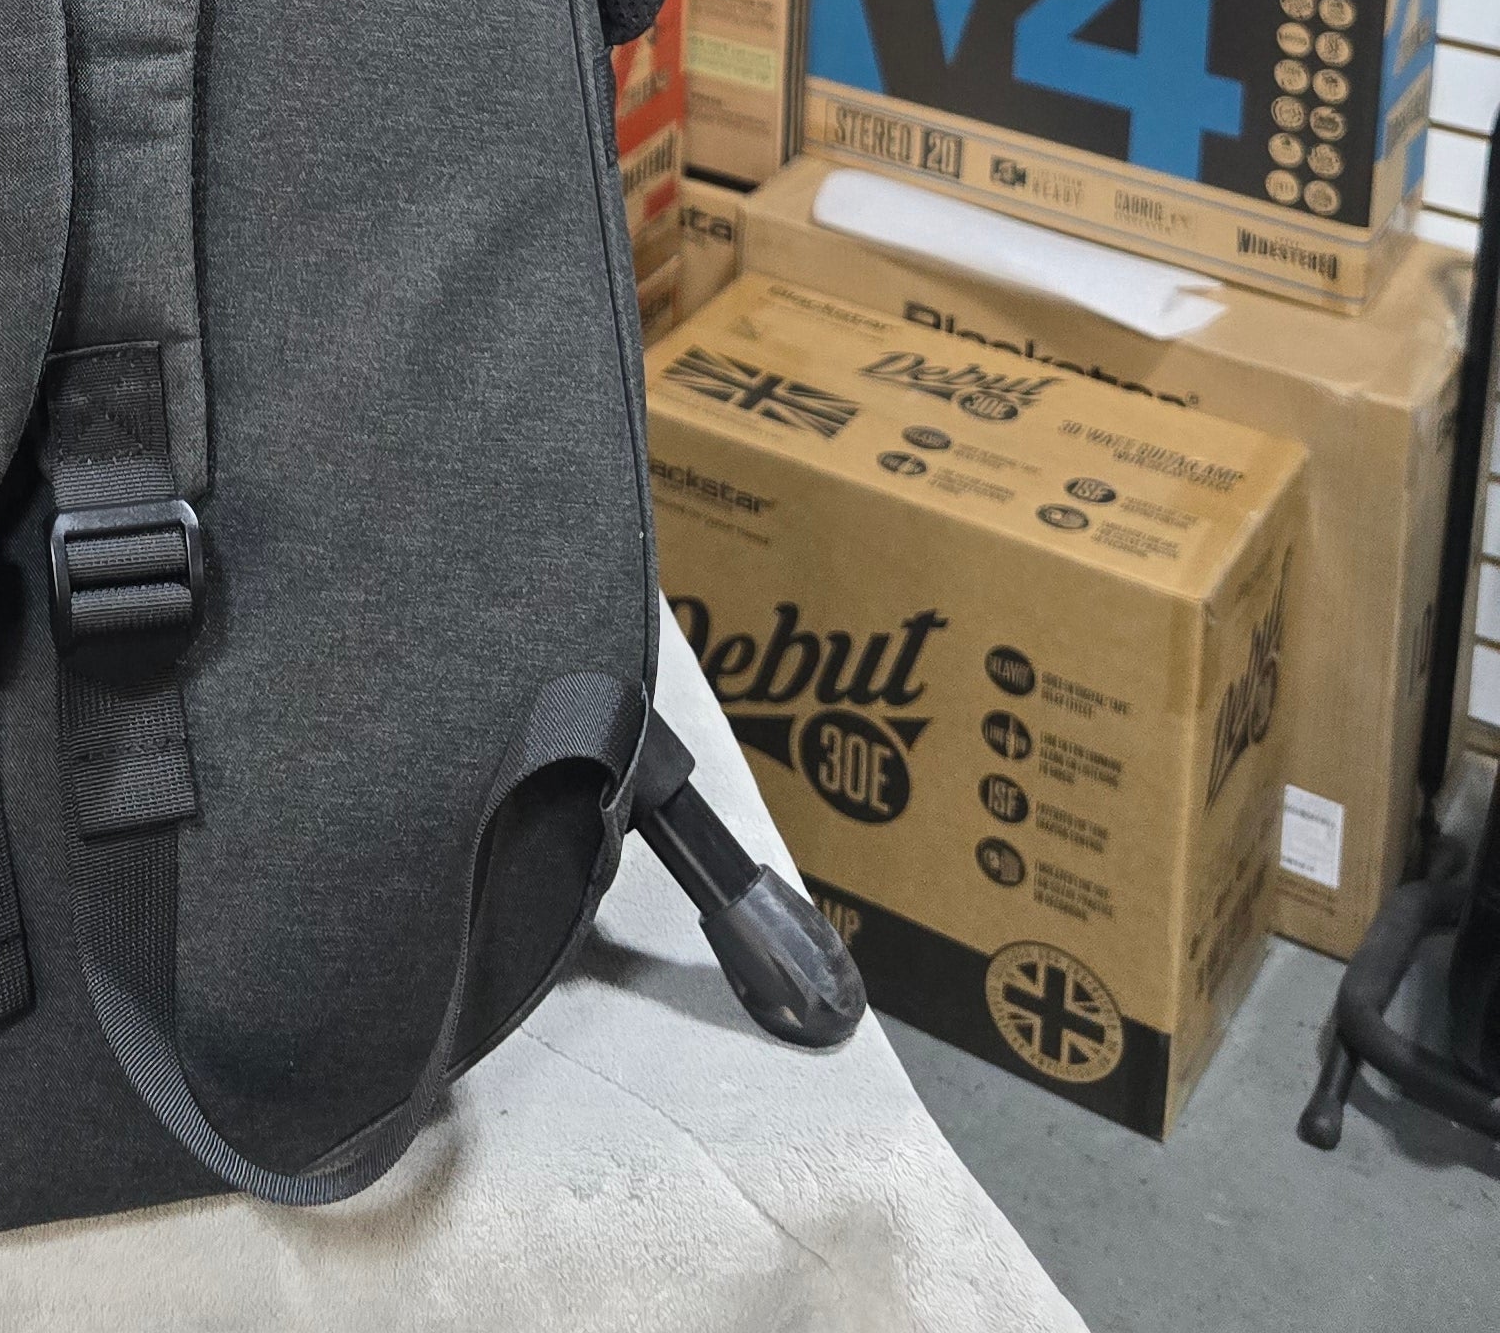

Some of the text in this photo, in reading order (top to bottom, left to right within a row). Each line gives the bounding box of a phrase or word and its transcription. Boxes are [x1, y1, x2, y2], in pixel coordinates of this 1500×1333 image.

[834, 105, 960, 178] STEREO 20
[859, 350, 1068, 396] Debut
[648, 458, 773, 514] ackstar
[818, 723, 893, 815] 30E
[987, 776, 1019, 818] ISF
